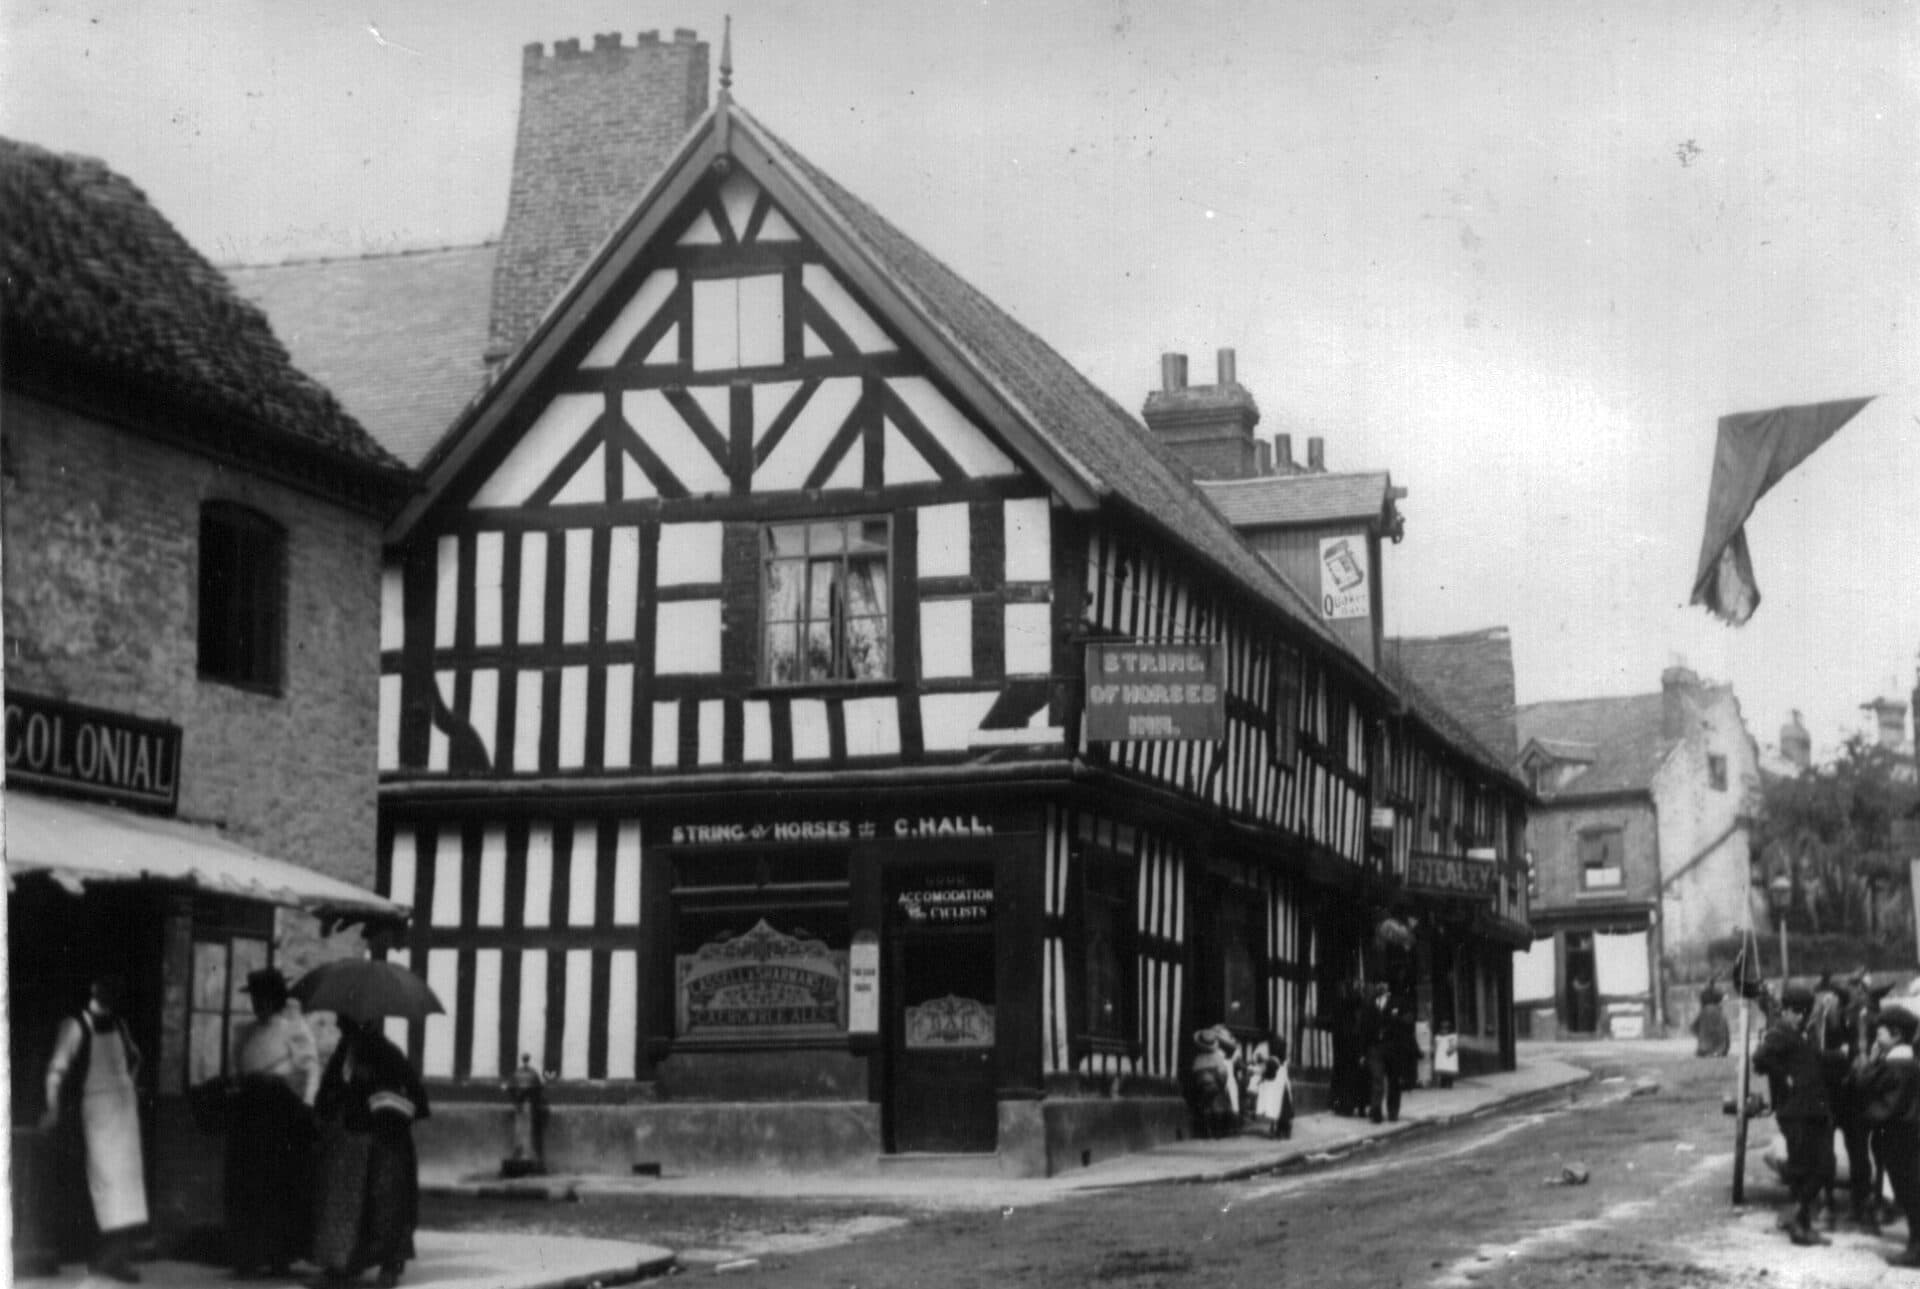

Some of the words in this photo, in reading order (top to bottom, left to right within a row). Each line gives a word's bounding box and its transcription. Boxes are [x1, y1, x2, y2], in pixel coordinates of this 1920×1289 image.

[1103, 652, 1205, 673] STRING
[1121, 684, 1217, 704] HORSES
[5, 704, 171, 791] COLONIAL
[672, 823, 744, 843] STRING
[774, 820, 851, 840] HORSES
[897, 888, 994, 904] ACCOMODATION
[930, 905, 987, 919] CYCLISTS
